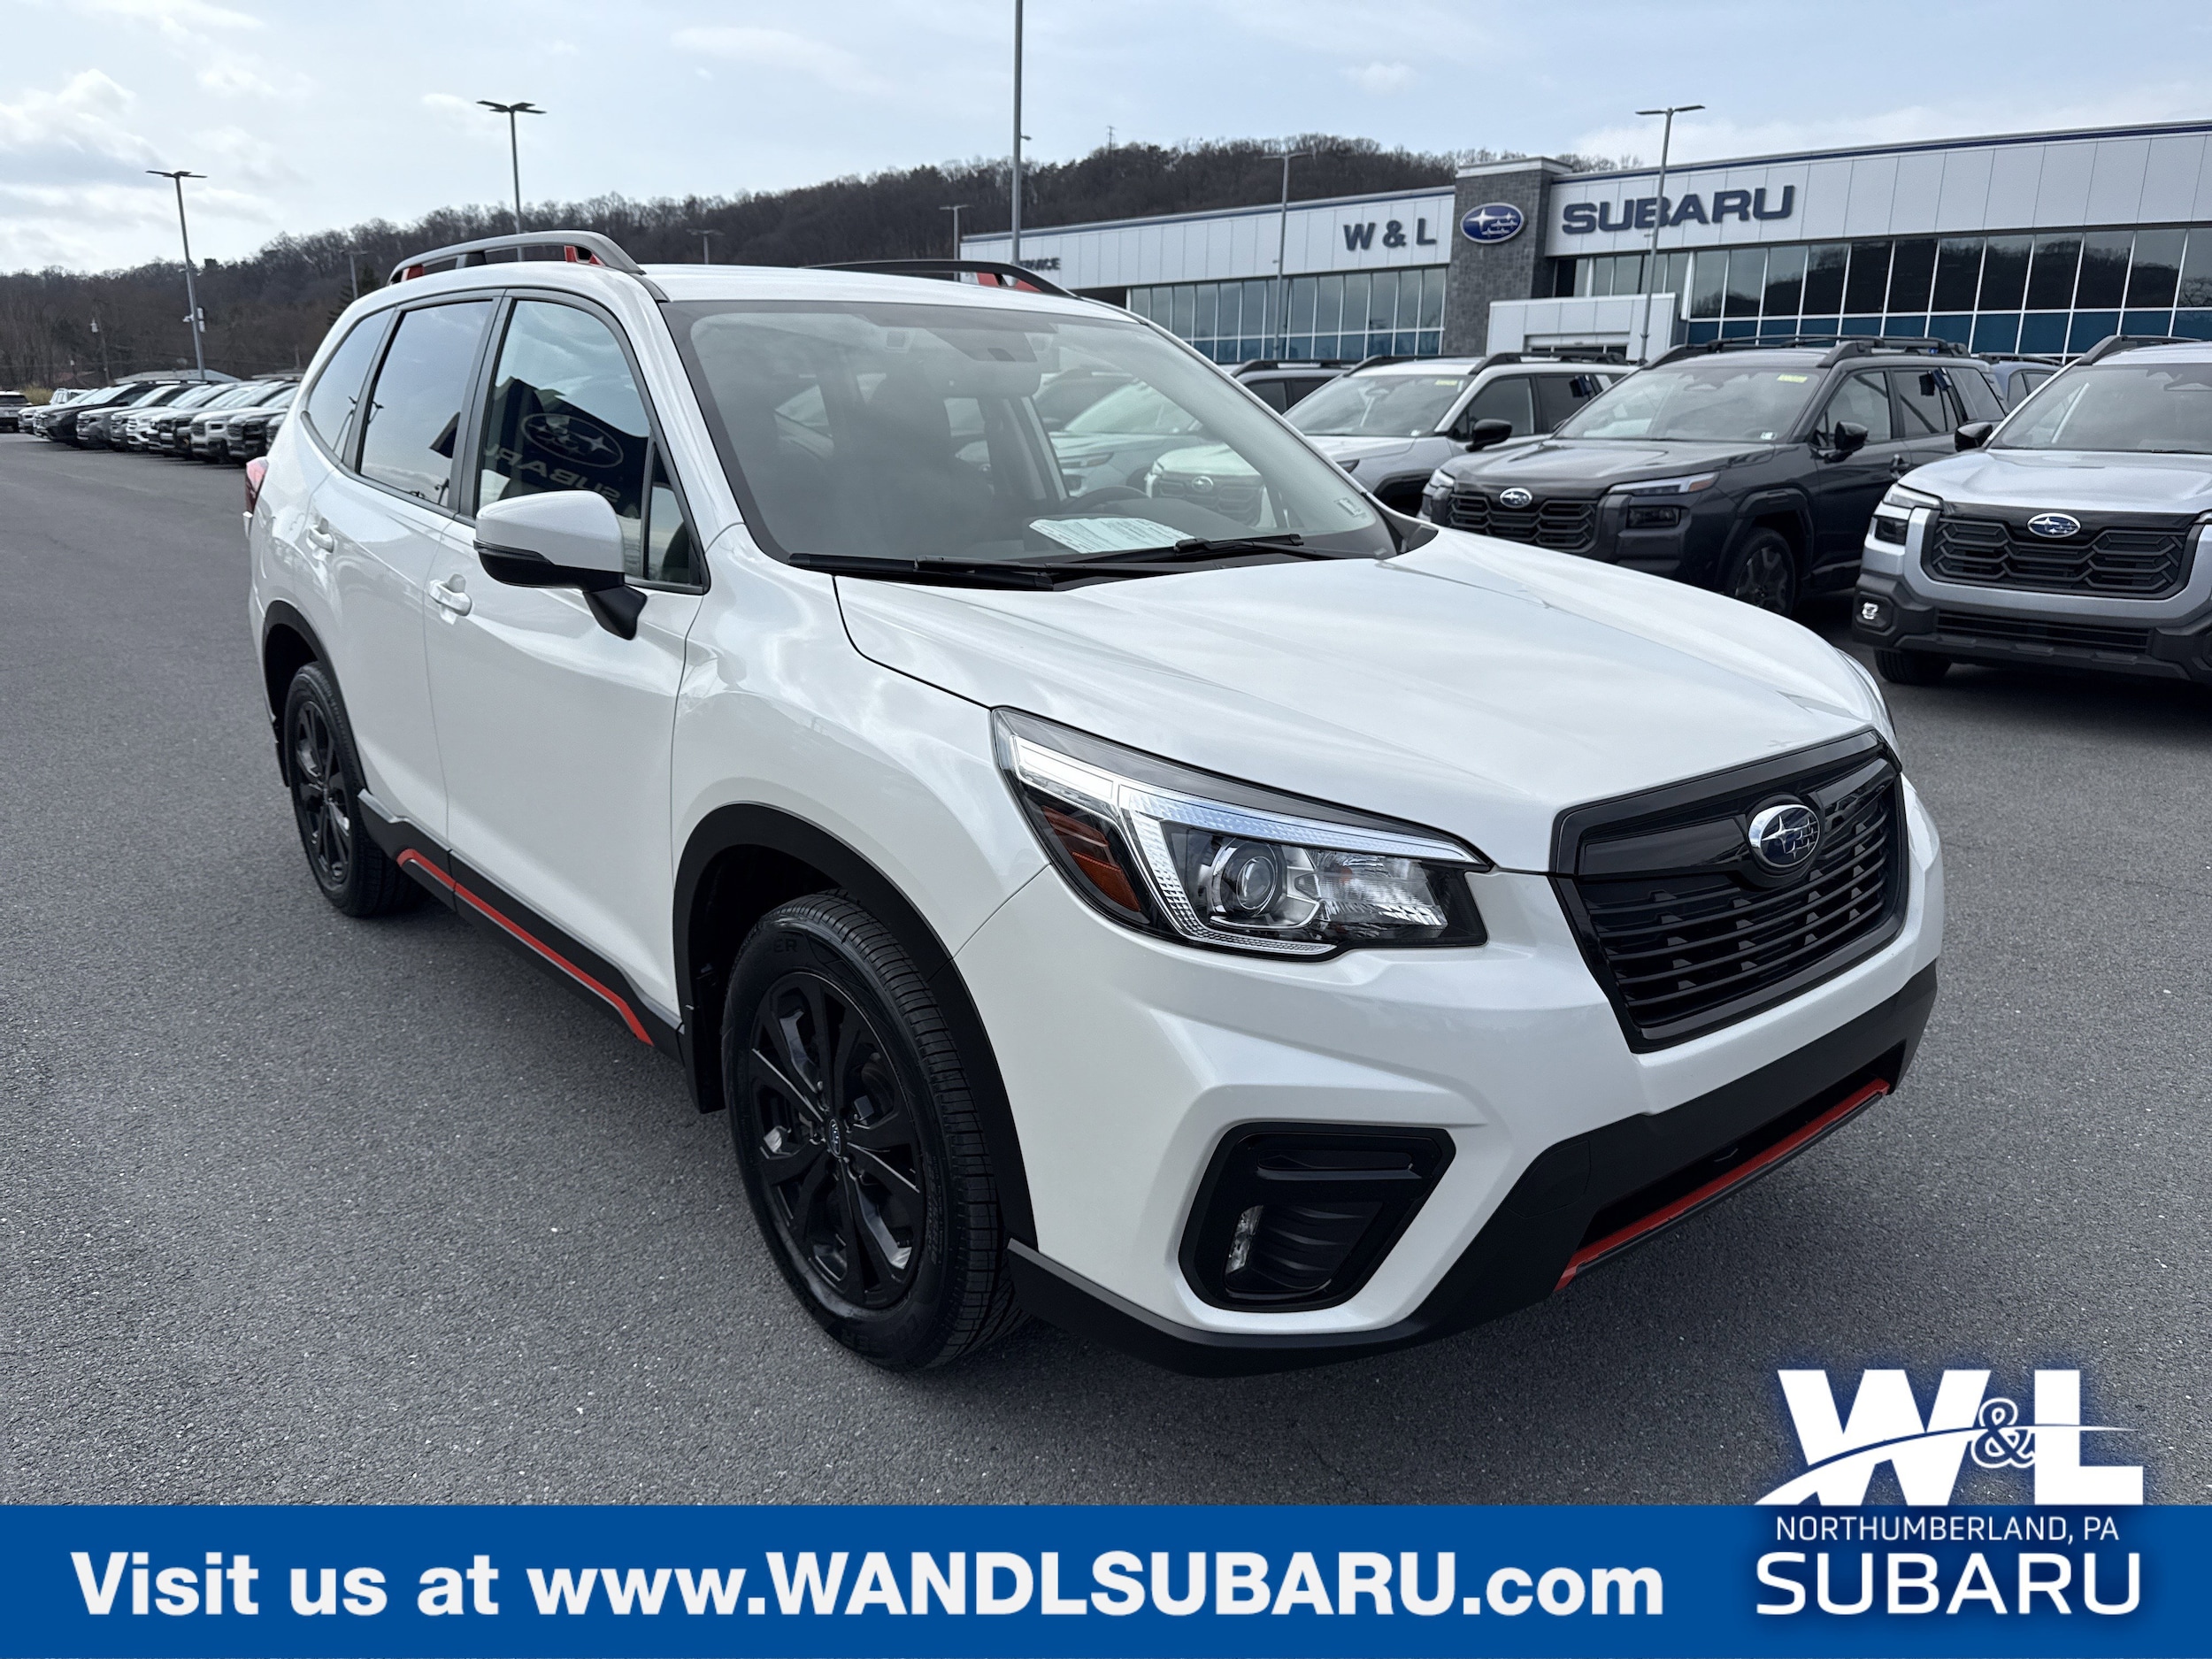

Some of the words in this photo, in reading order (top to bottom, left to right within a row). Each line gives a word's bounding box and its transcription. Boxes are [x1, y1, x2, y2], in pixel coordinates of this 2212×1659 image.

[1562, 184, 1795, 235] SUBARU
[1343, 221, 1376, 251] W
[1382, 219, 1407, 249] &
[1416, 218, 1437, 246] L
